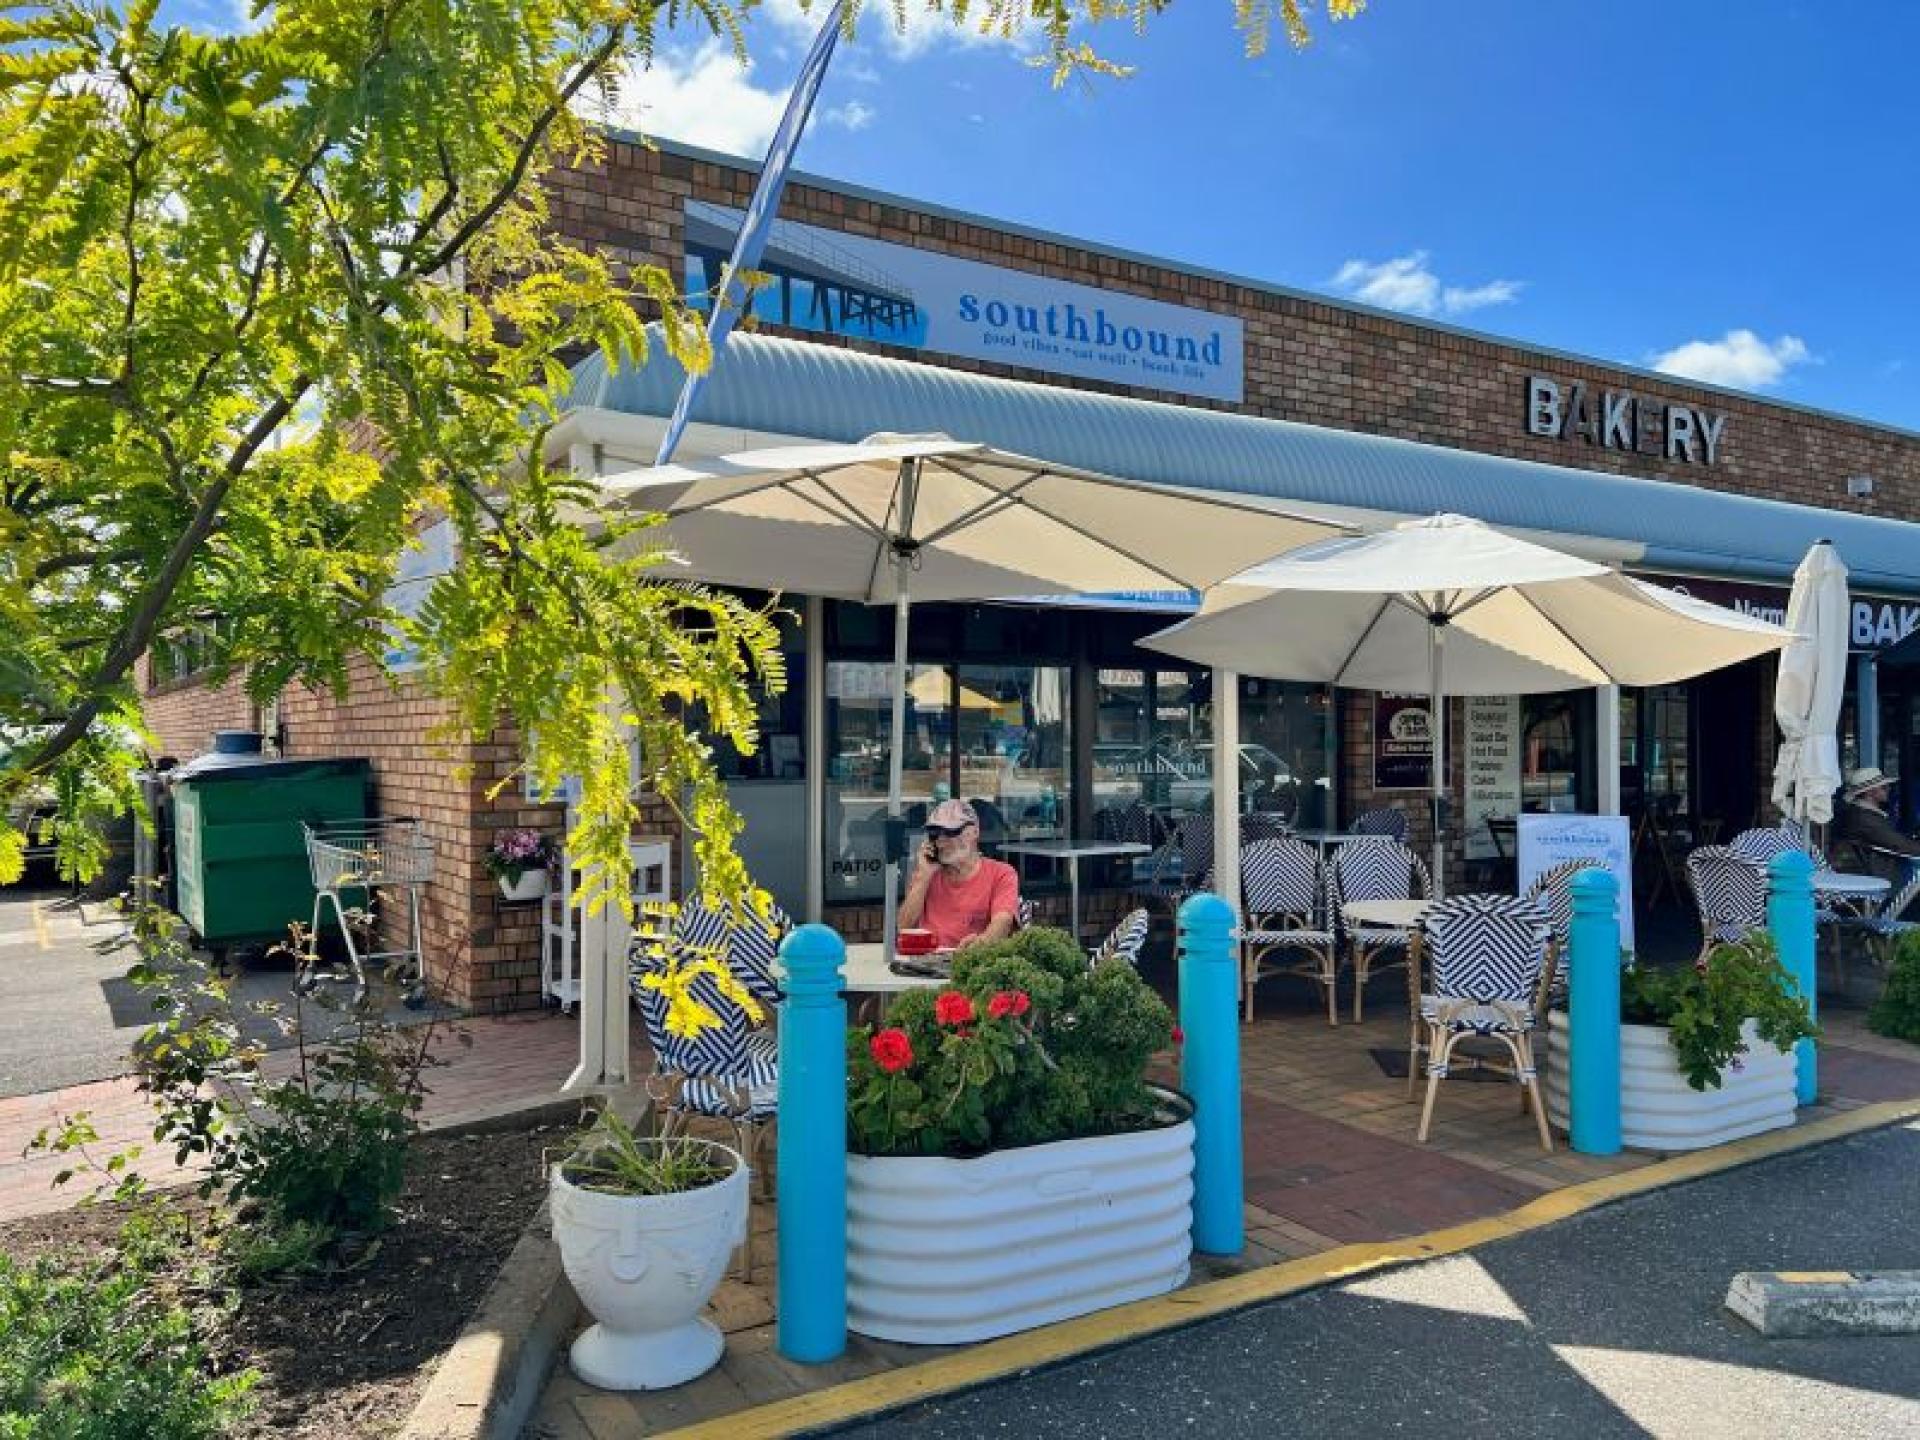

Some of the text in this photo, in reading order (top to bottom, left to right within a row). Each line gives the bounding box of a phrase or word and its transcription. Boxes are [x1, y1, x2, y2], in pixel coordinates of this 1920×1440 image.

[959, 294, 1221, 366] southbound
[1526, 374, 1725, 465] BAKERY
[832, 859, 882, 874] PATIO
